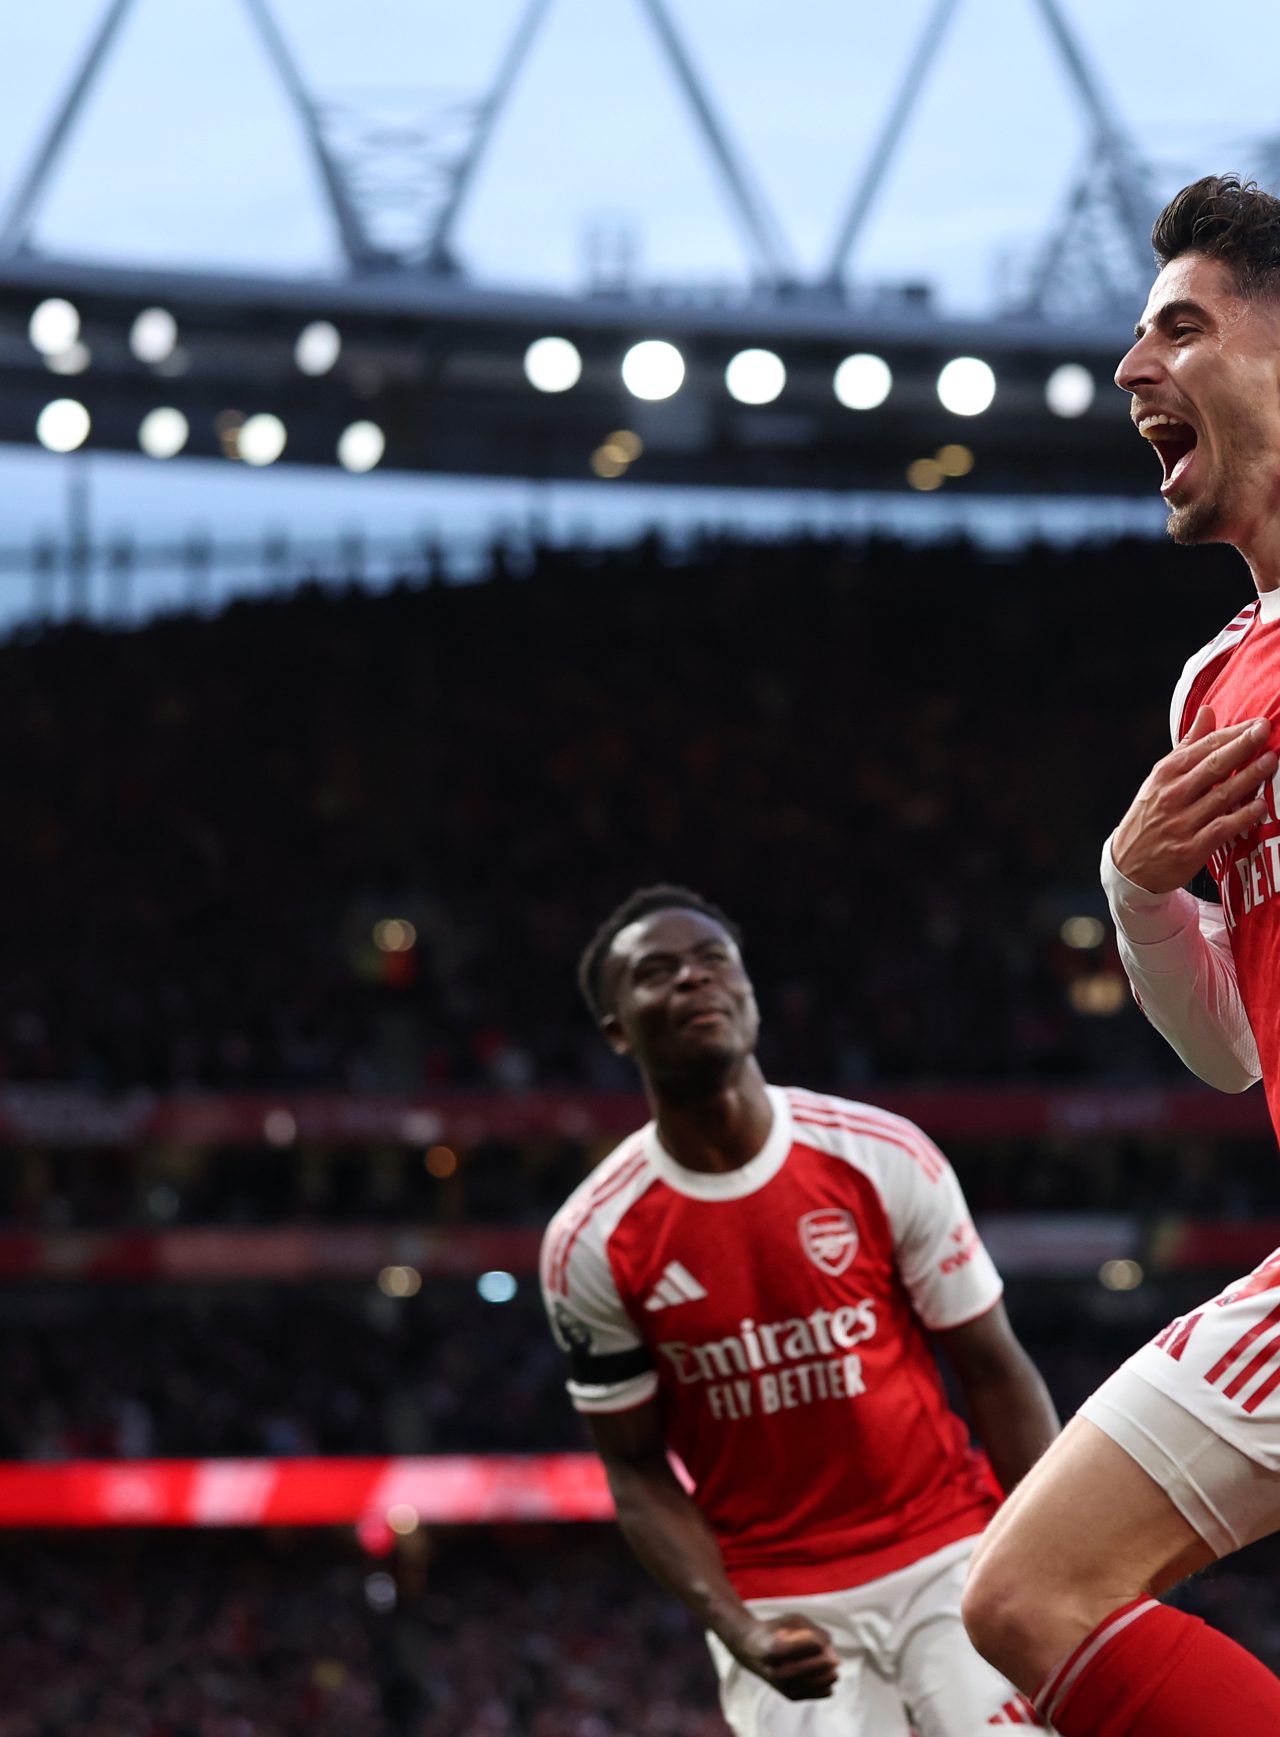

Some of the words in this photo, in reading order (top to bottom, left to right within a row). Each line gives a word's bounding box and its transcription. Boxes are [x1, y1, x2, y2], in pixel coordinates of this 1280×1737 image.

[658, 1298, 878, 1384] Emirates
[706, 1378, 753, 1420] FLY
[757, 1353, 867, 1415] BETTER
